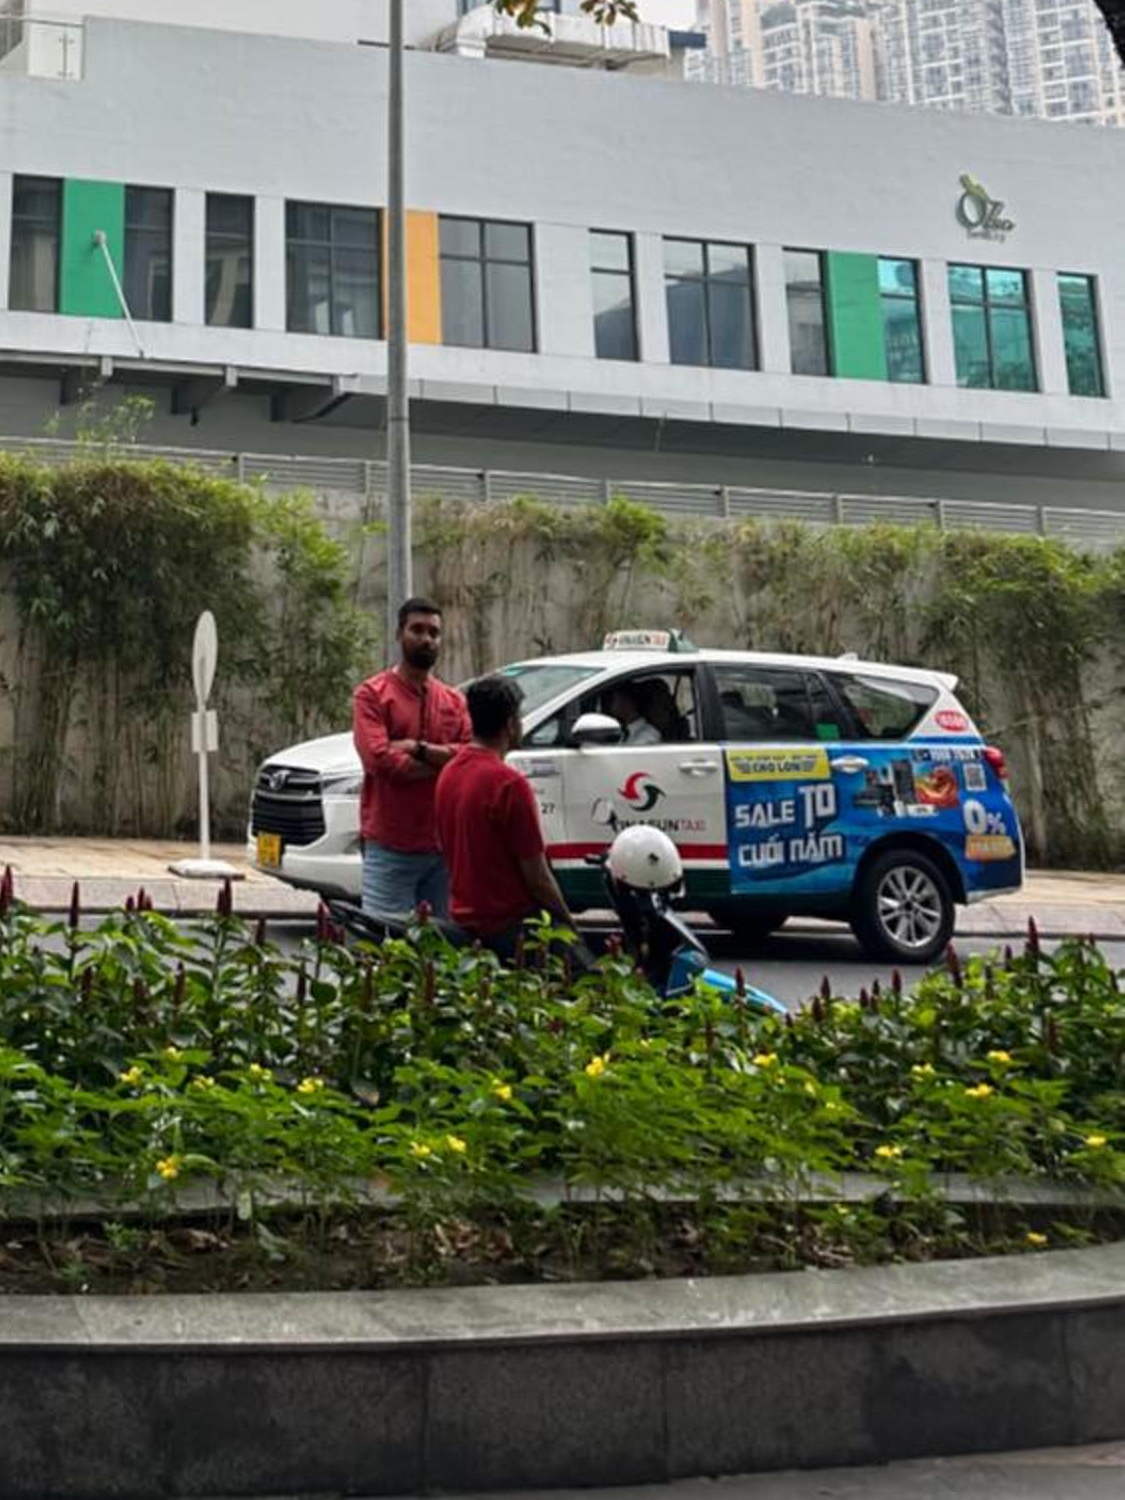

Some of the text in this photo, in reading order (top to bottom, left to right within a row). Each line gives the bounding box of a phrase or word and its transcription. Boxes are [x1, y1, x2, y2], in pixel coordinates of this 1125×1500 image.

[734, 783, 837, 829] SALE TO
[962, 798, 1007, 836] 0%
